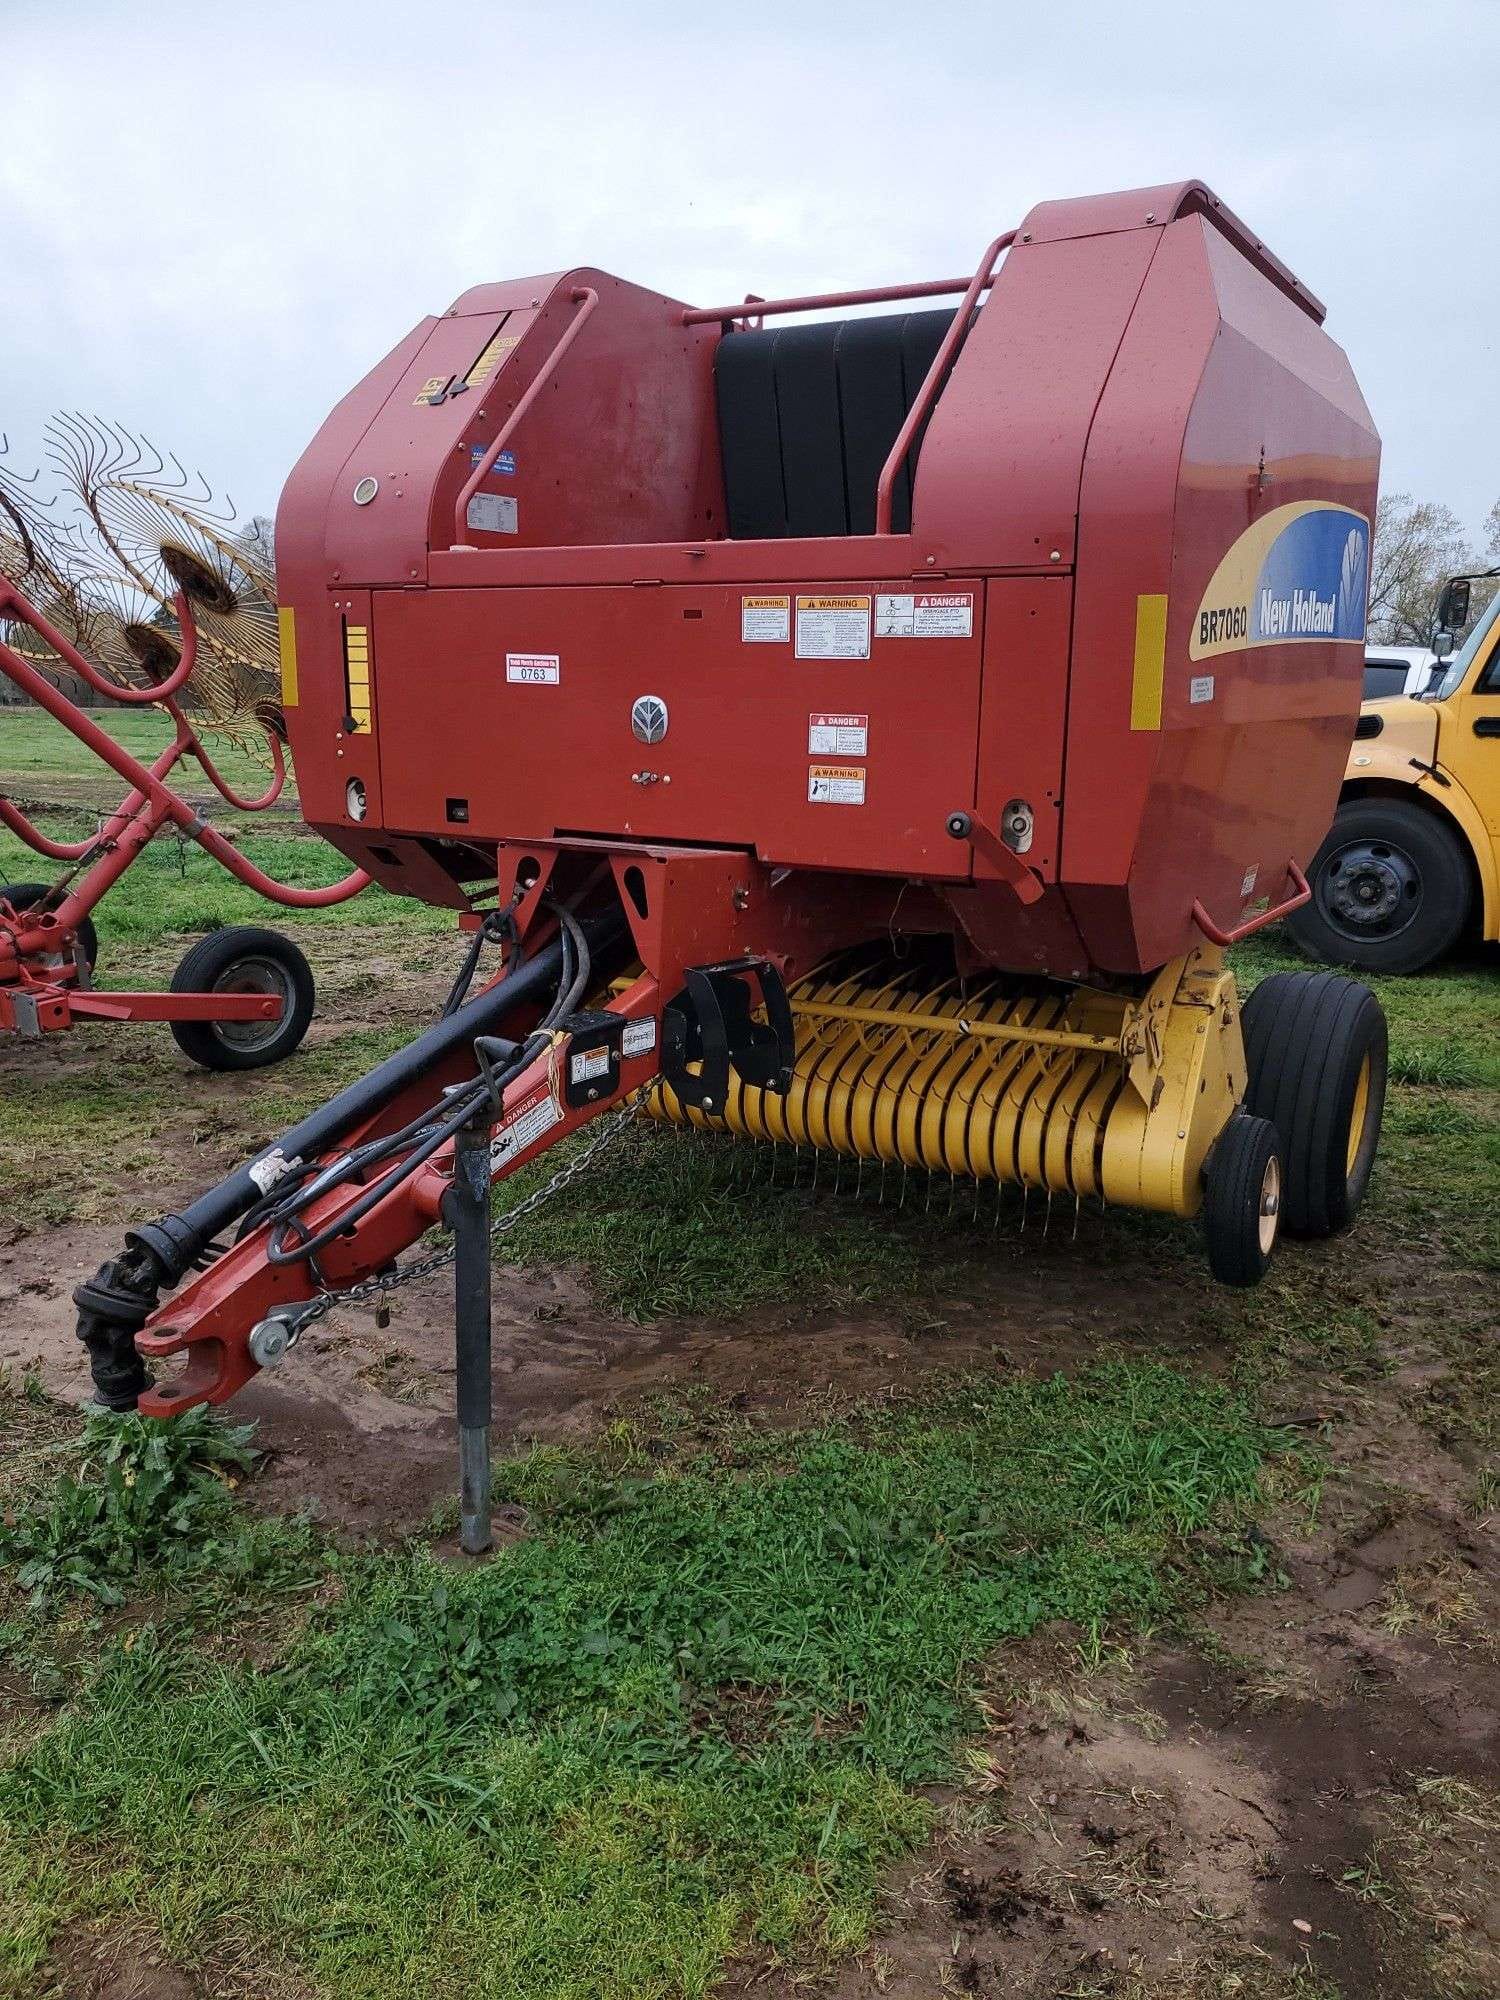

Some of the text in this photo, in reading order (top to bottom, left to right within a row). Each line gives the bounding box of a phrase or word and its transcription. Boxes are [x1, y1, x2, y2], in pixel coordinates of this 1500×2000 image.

[754, 599, 784, 607] WARNING
[818, 599, 858, 608] WARNING
[930, 597, 968, 606] DANGER
[1260, 588, 1336, 635] New Holland
[1200, 606, 1247, 645] BR7060
[521, 668, 546, 680] 0763
[828, 717, 859, 726] DANGER
[822, 769, 858, 778] WARNING
[506, 1097, 538, 1123] DANGER
